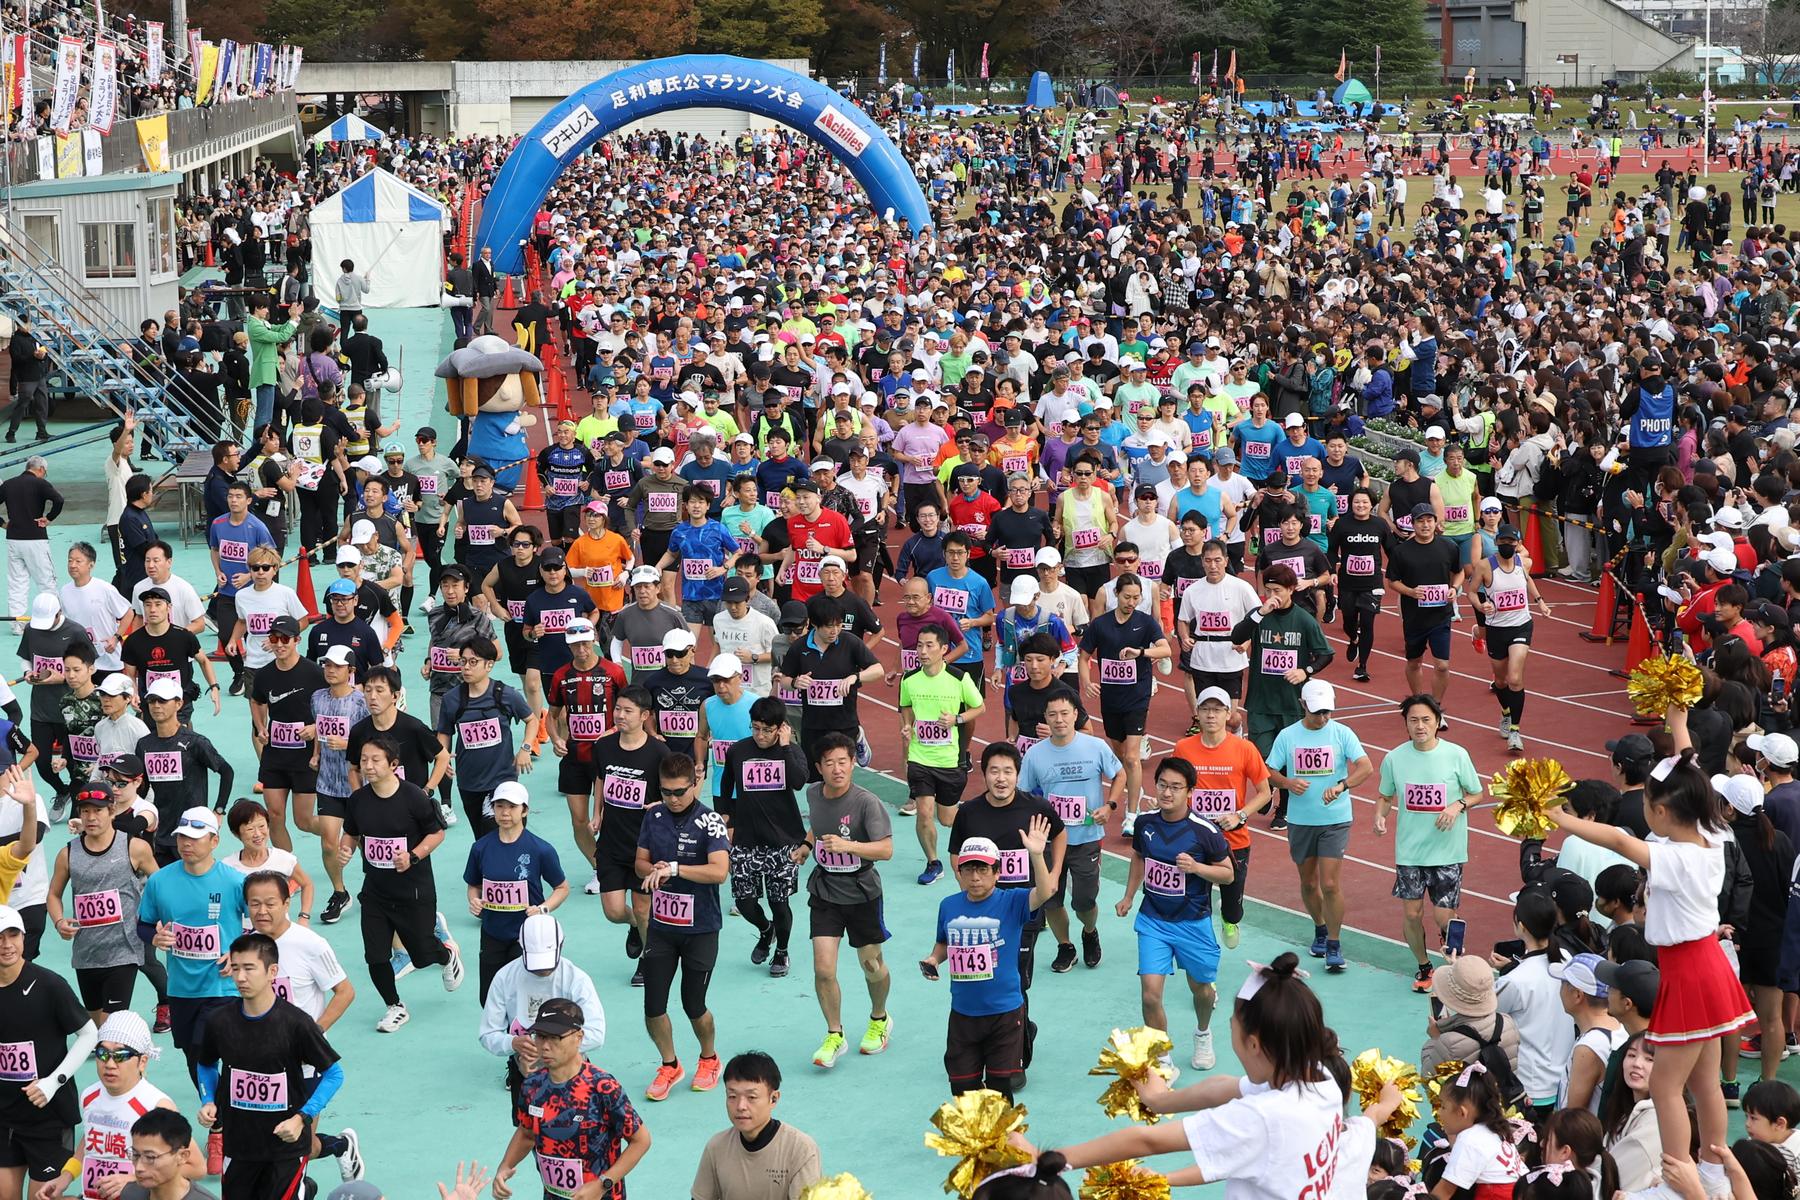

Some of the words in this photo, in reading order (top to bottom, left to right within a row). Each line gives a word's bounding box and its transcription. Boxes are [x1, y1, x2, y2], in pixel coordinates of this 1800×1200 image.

[610, 73, 805, 110] 足利尊氏公マラソン大会
[546, 110, 594, 151] アキレス
[820, 108, 864, 151] Achilles
[1152, 377, 1170, 385] LIXI
[788, 390, 800, 399] 134
[1068, 385, 1085, 396] 186
[1130, 401, 1142, 411] 218
[1235, 399, 1249, 409] 211
[635, 416, 653, 426] 7053
[1640, 418, 1671, 430] PHOTO
[1052, 424, 1061, 433] 10
[1191, 433, 1209, 445] 2143
[1248, 445, 1268, 455] 5055
[1005, 460, 1026, 470] 4172
[1289, 461, 1300, 469] 32
[419, 479, 435, 490] 059
[607, 473, 627, 484] 2266
[555, 481, 576, 491] 30001
[650, 496, 676, 507] 30003
[769, 496, 779, 506] 41
[858, 501, 869, 511] 76
[1336, 499, 1346, 509] 35
[1399, 514, 1411, 524] 40
[1446, 509, 1468, 519] 1048
[471, 529, 491, 540] 3291
[1076, 531, 1099, 545] 2115
[1267, 533, 1282, 544] 305
[1347, 533, 1379, 544] adidas
[222, 544, 244, 558] 4058
[742, 541, 755, 551] 179
[1009, 552, 1032, 564] 2134
[1137, 564, 1160, 575] 4190
[1350, 560, 1371, 570] 7007
[592, 571, 609, 582] 017
[800, 566, 818, 578] 327
[937, 594, 964, 609] 4115
[1498, 593, 1524, 607] 2278
[510, 608, 526, 619] 505
[1201, 615, 1228, 628] 2150
[722, 631, 748, 641] NIKE
[1284, 631, 1302, 647] STAR
[635, 652, 661, 665] 1104
[903, 655, 921, 668] 106
[1264, 655, 1294, 669] 4033
[1014, 668, 1027, 680] 23
[1104, 665, 1133, 678] 4089
[810, 685, 840, 699] 3276
[568, 704, 607, 713] SHIYA
[318, 721, 345, 736] 3285
[572, 719, 601, 734] 2009
[663, 717, 694, 731] 1030
[273, 728, 300, 741] 4078
[465, 728, 497, 743] 3133
[148, 758, 177, 774] 3082
[1298, 752, 1330, 769] 1067
[747, 768, 781, 783] 4184
[1060, 766, 1083, 776] 2022
[607, 783, 641, 803] 4088
[1407, 790, 1442, 805] 2253
[1196, 796, 1231, 811] 3302
[694, 812, 726, 830] Mo
[707, 822, 729, 841] Sp
[1000, 858, 1023, 874] 161
[1154, 862, 1173, 872] アキレス
[1148, 868, 1181, 889] 4025
[83, 893, 105, 901] アキレス
[487, 888, 521, 903] 6011
[80, 898, 116, 920] 2039
[655, 897, 688, 918] 2107
[176, 934, 215, 951] 3040
[951, 953, 987, 973] 1143
[245, 1073, 271, 1082] アキレス
[236, 1079, 280, 1102] 5097
[87, 1127, 127, 1159] 矢崎
[1303, 1113, 1342, 1179] LOVE
[95, 1159, 119, 1169] アキレス
[540, 1157, 565, 1167] アキレス
[545, 1165, 577, 1189] 128
